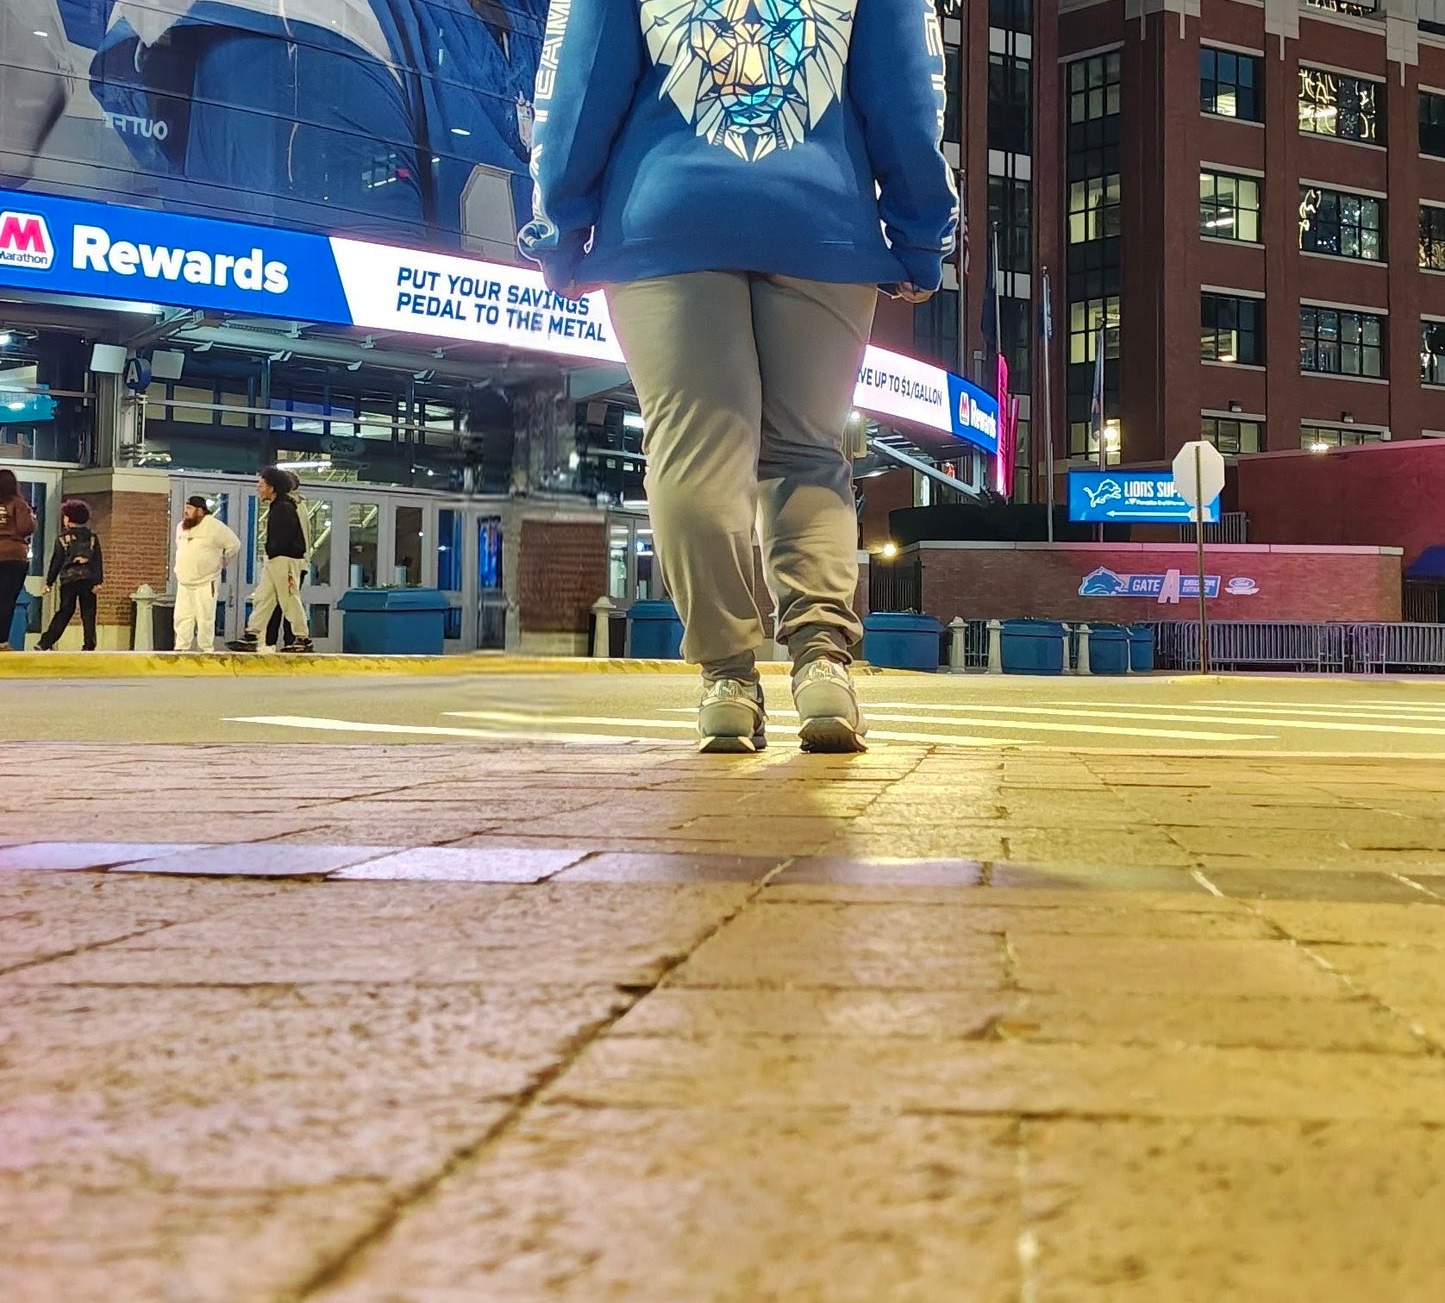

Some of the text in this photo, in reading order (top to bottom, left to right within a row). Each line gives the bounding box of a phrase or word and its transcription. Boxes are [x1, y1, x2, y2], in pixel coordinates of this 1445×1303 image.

[73, 224, 289, 294] Rewards
[397, 266, 590, 316] PUT YOUR SAVINGS
[397, 292, 607, 342] PEDAL TO THE METAL
[874, 370, 887, 390] UP
[889, 374, 900, 394] TO
[901, 376, 943, 407] $1/GALLON
[1132, 569, 1180, 604] GATE A
